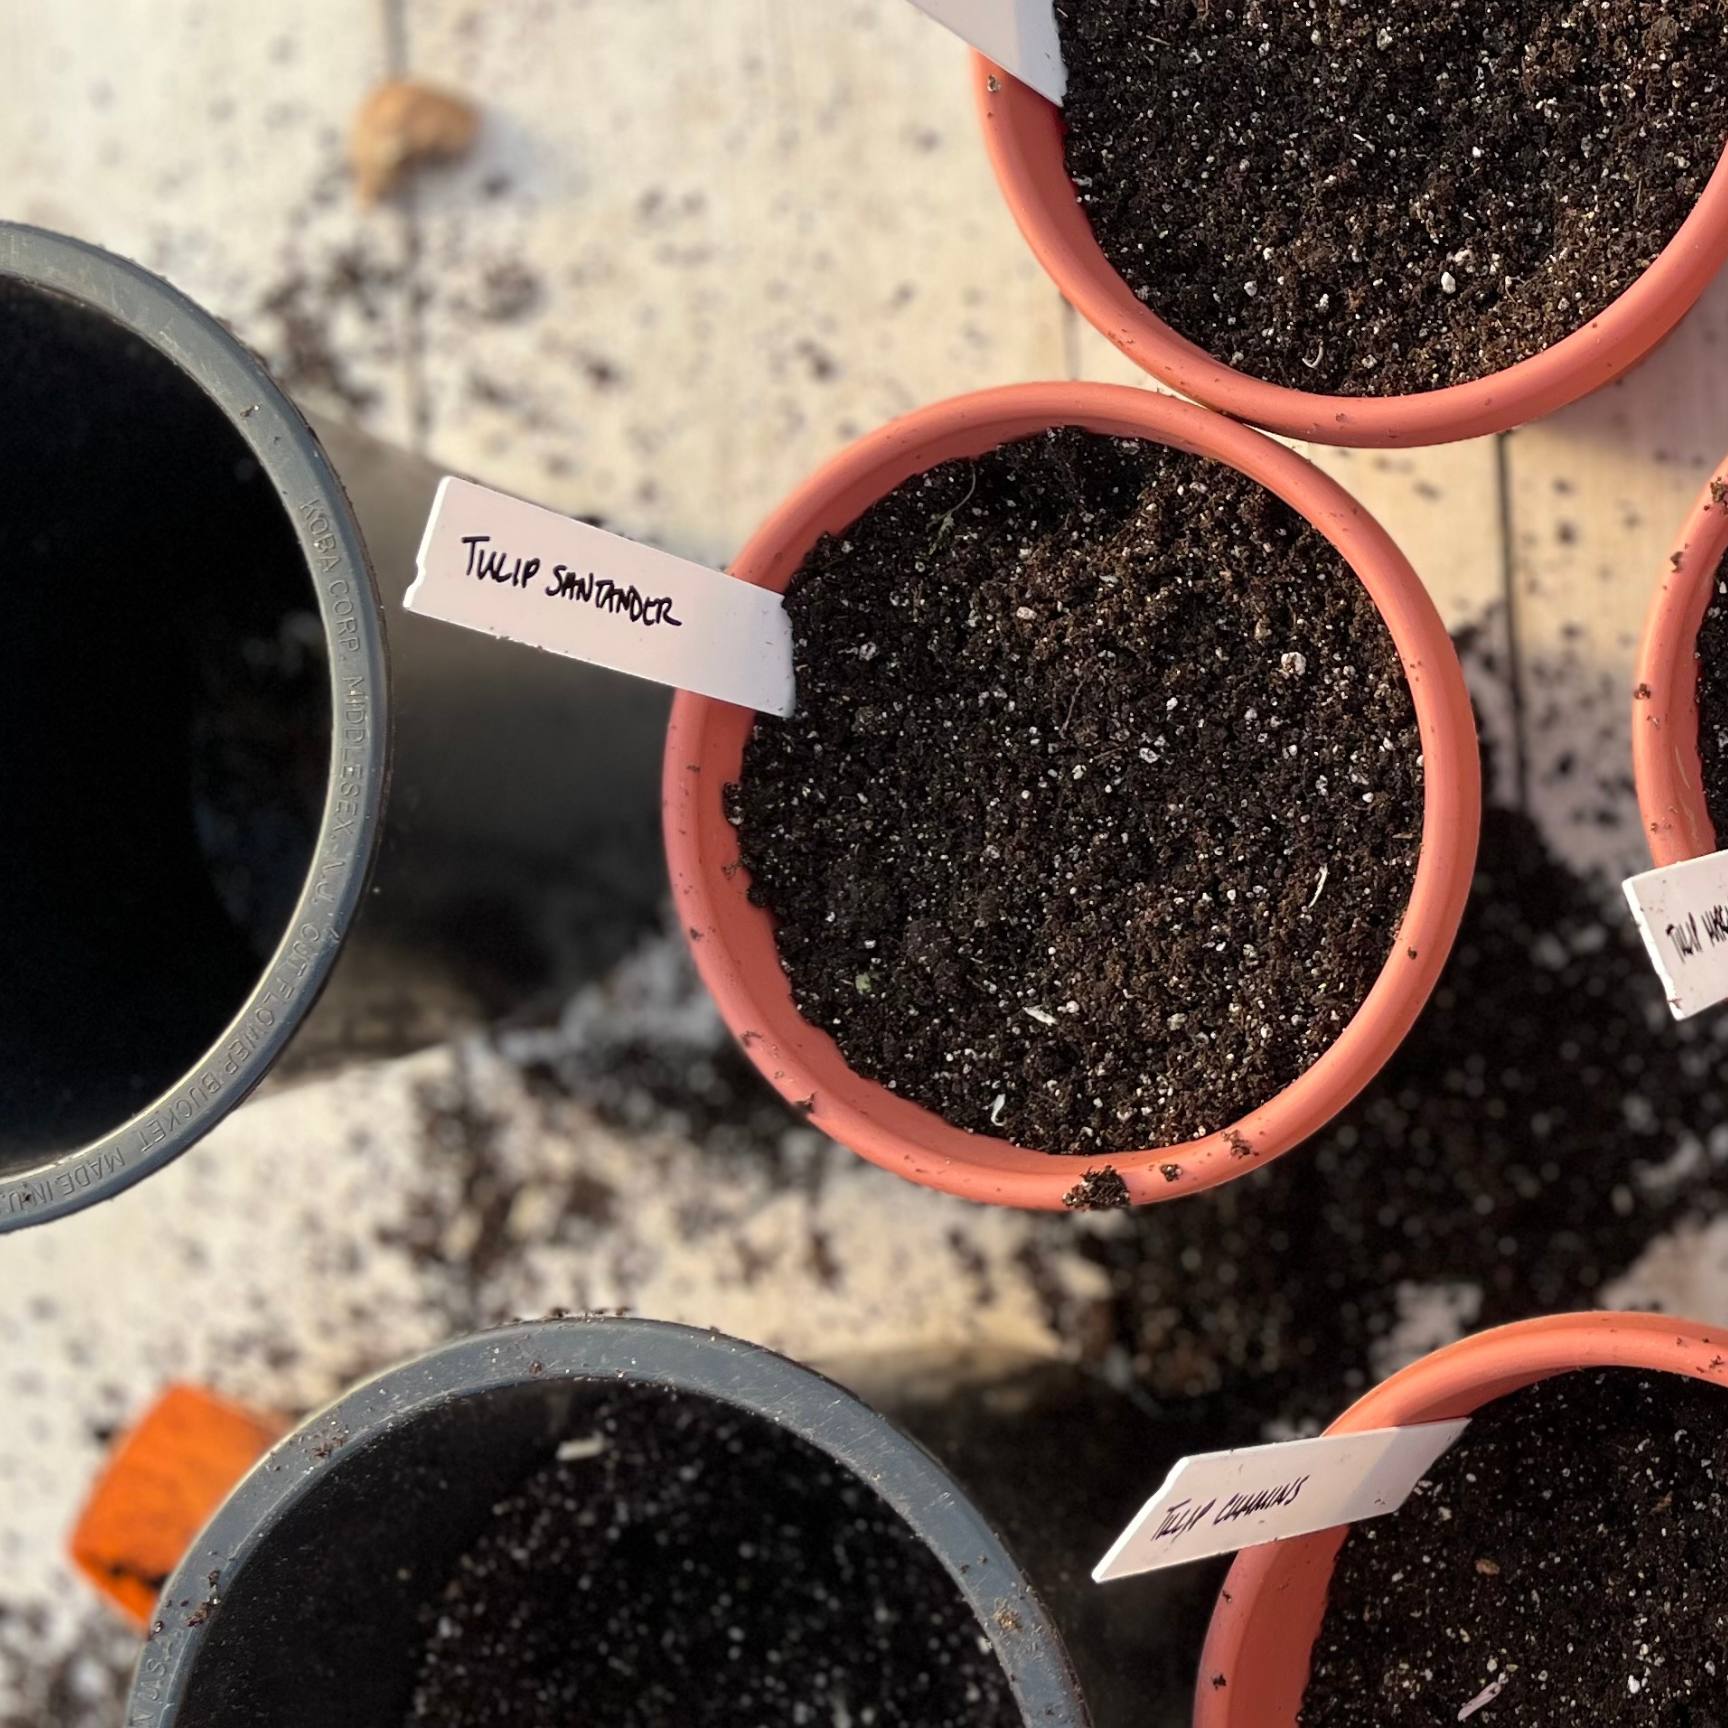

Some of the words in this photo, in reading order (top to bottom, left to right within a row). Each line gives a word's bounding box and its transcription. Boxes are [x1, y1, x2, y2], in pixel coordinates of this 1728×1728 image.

[300, 498, 343, 573] KOBA
[461, 535, 541, 588] TULIP
[545, 565, 682, 627] SANTANDER
[287, 922, 320, 977] CUT
[136, 1071, 222, 1153] BUCKET
[31, 1181, 54, 1207] IN
[55, 1147, 126, 1196] MADE
[1151, 1499, 1216, 1543] TULIP
[1213, 1475, 1310, 1526] CUMMINS
